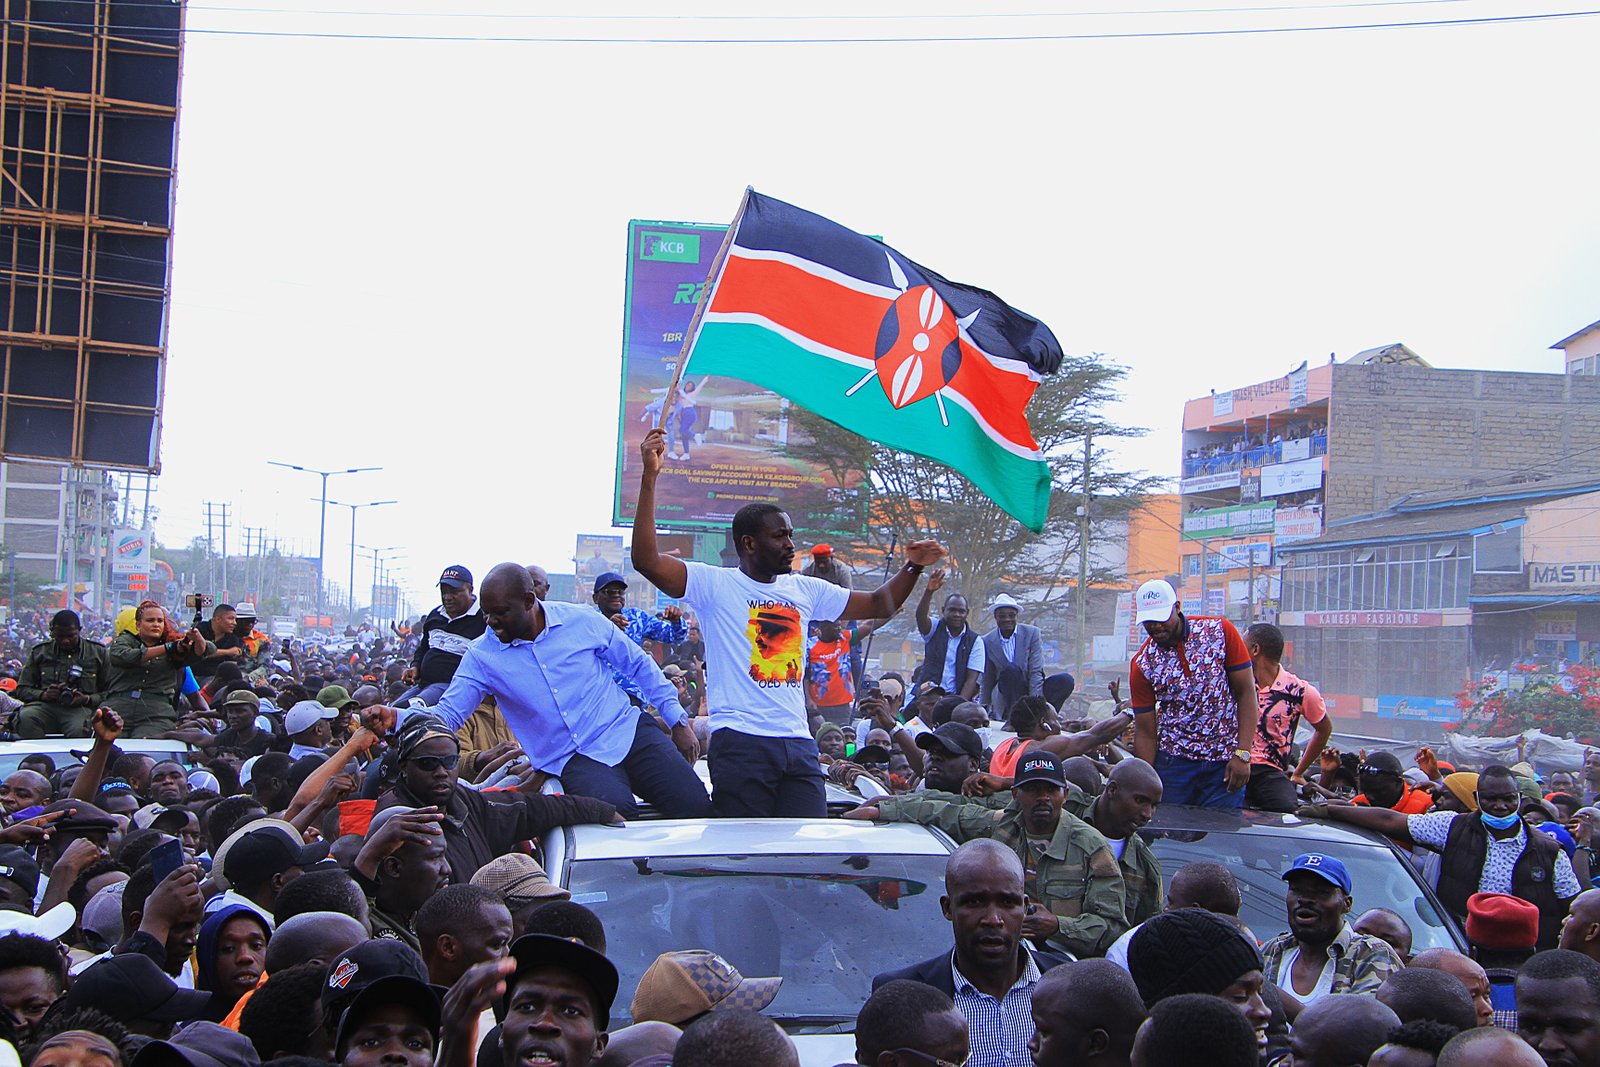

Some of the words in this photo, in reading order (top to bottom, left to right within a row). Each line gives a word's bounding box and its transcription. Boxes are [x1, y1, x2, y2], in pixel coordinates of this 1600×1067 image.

[660, 241, 685, 254] KCB
[692, 469, 720, 477] SAVINGS
[721, 471, 753, 479] ACCOUNT
[746, 599, 775, 610] WHO
[1319, 613, 1357, 625] KAMESH
[1366, 613, 1419, 625] FASHIONS
[756, 679, 781, 689] OLD
[1304, 855, 1323, 867] E
